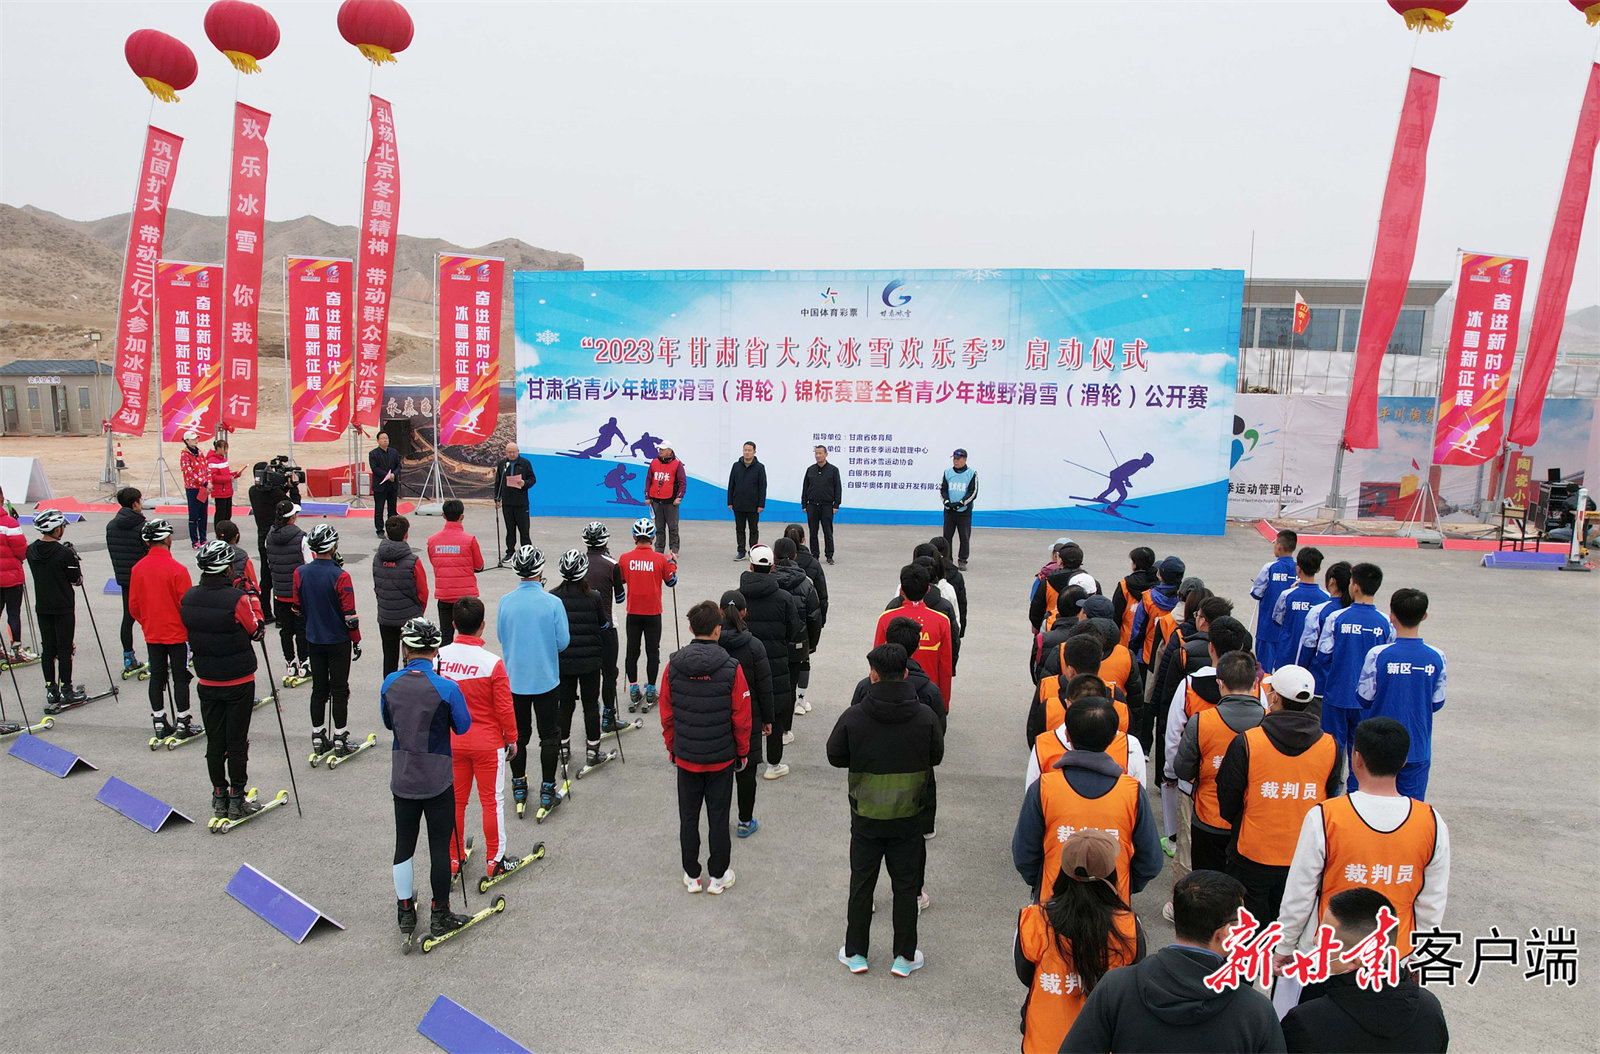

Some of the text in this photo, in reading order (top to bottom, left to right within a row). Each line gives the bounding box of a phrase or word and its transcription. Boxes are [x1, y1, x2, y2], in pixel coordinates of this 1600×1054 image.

[367, 107, 395, 256] 弘扬北京冬奥精神
[119, 138, 172, 426] 巩固扩大 带动三亿人参加冰雪运动
[229, 117, 264, 417] 欢乐冰雪 你我同行
[175, 310, 191, 392] 冰雪新征程
[196, 296, 211, 378] 奋进新时代
[305, 306, 321, 391] 冰雪新征程
[326, 291, 341, 375] 奋进新时代
[455, 305, 469, 393] 冰雪新征程
[475, 290, 490, 377] 奋进新时代
[581, 336, 1149, 371] “2023年甘肃省大众冰雪欢乐季” 启动仪式
[800, 308, 858, 317] 中国体育彩票
[1483, 293, 1511, 390] 奋进新时代
[1455, 310, 1483, 407] 冰雪新征程
[849, 457, 914, 466] 甘肃省冰雪运动协会
[629, 560, 654, 572] CHINA
[440, 661, 479, 676] CHINA
[1341, 623, 1383, 637] 新区一中
[1387, 662, 1435, 676] 新区一中
[1260, 781, 1317, 800] 裁判员
[1344, 863, 1414, 885] 裁判员
